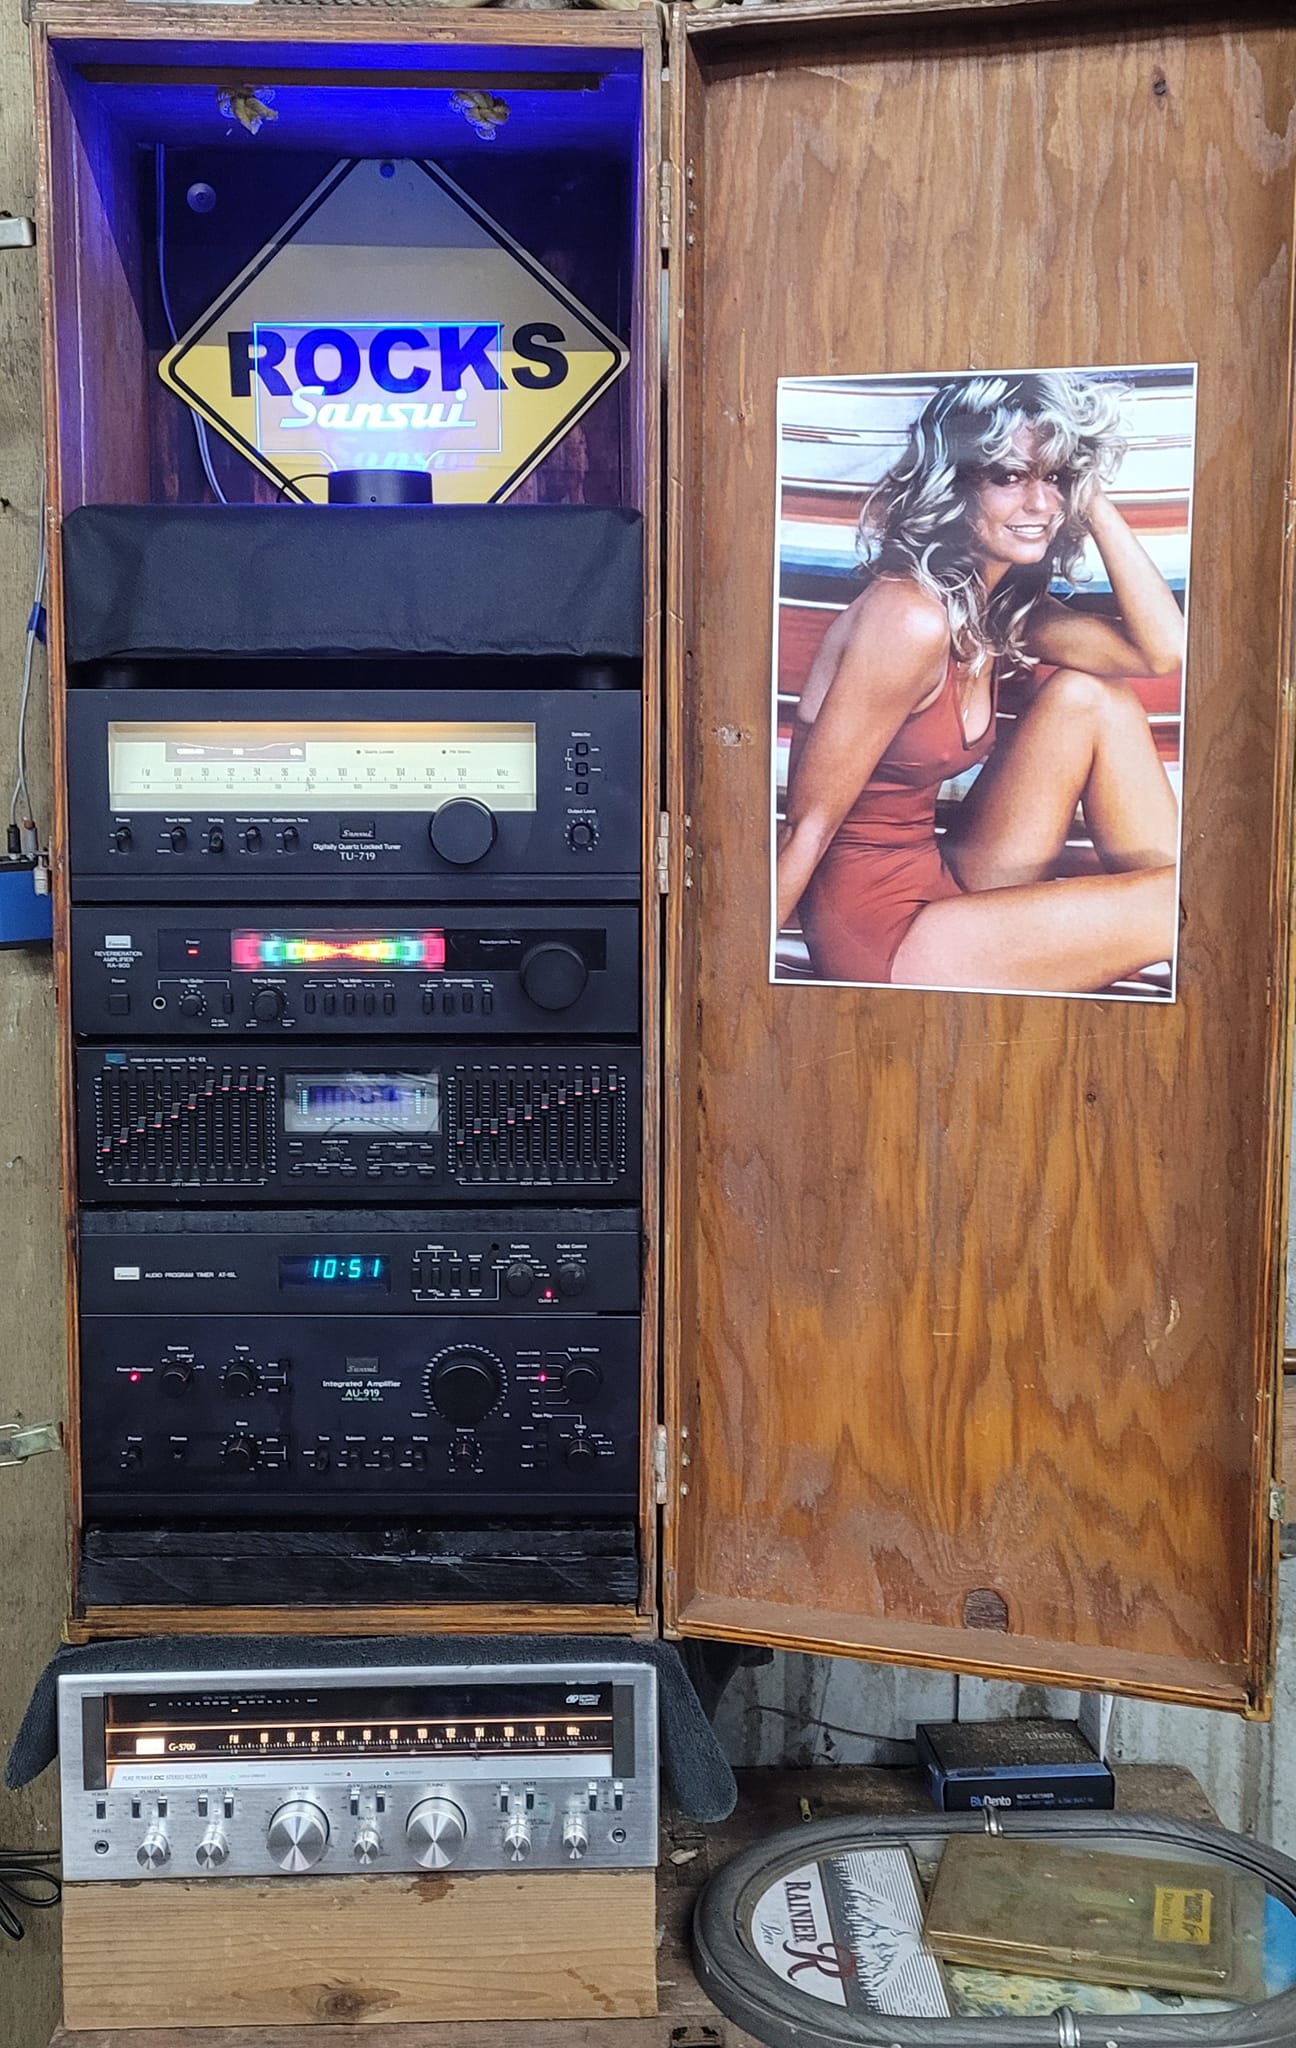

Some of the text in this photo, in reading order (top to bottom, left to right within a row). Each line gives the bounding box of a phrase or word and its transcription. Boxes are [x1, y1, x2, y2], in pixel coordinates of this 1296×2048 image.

[227, 322, 569, 397] ROCKS
[280, 386, 476, 429] Sansui
[312, 843, 337, 851] Digitally
[340, 852, 376, 861] TU-719
[313, 1258, 380, 1278] 10:51
[322, 1380, 401, 1389] Integrated Amplifier
[345, 1389, 380, 1398] AU-919
[970, 1794, 1012, 1807] BluDento
[785, 1881, 818, 1942] RAINIER
[782, 1939, 857, 1982] R
